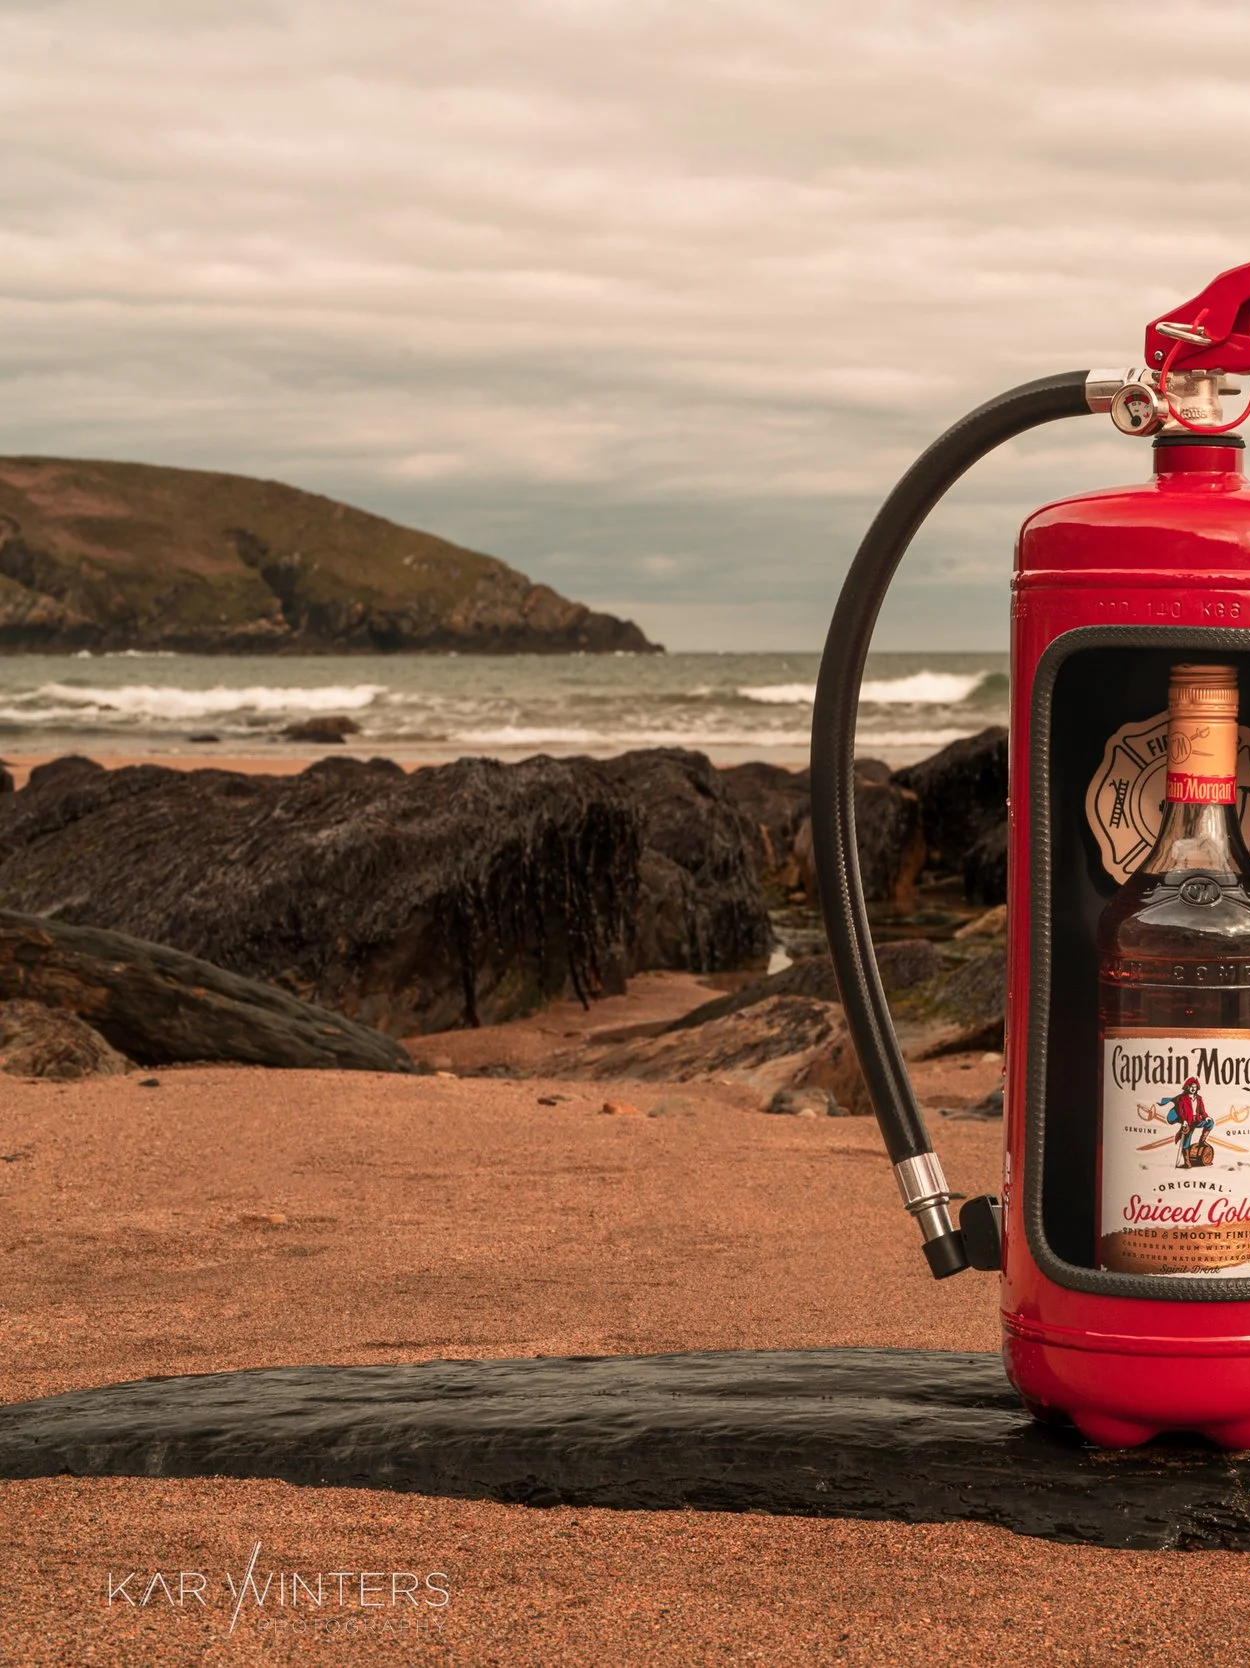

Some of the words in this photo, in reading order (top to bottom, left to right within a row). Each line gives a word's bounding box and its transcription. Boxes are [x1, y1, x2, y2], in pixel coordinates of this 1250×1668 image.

[1184, 778, 1232, 803] Morgan
[1112, 1045, 1189, 1091] Captain
[1124, 1126, 1157, 1135] GENUINE
[1158, 1181, 1224, 1193] ORIGINAL
[1123, 1194, 1204, 1224] Spiced
[1122, 1227, 1158, 1238] SPICED
[1161, 1231, 1169, 1240] &
[1172, 1231, 1222, 1240] SMOOTH
[1122, 1240, 1174, 1250] CARIBBEAN
[1140, 1253, 1168, 1261] OTHER
[1159, 1263, 1189, 1274] Spirit
[1190, 1264, 1221, 1274] Drink
